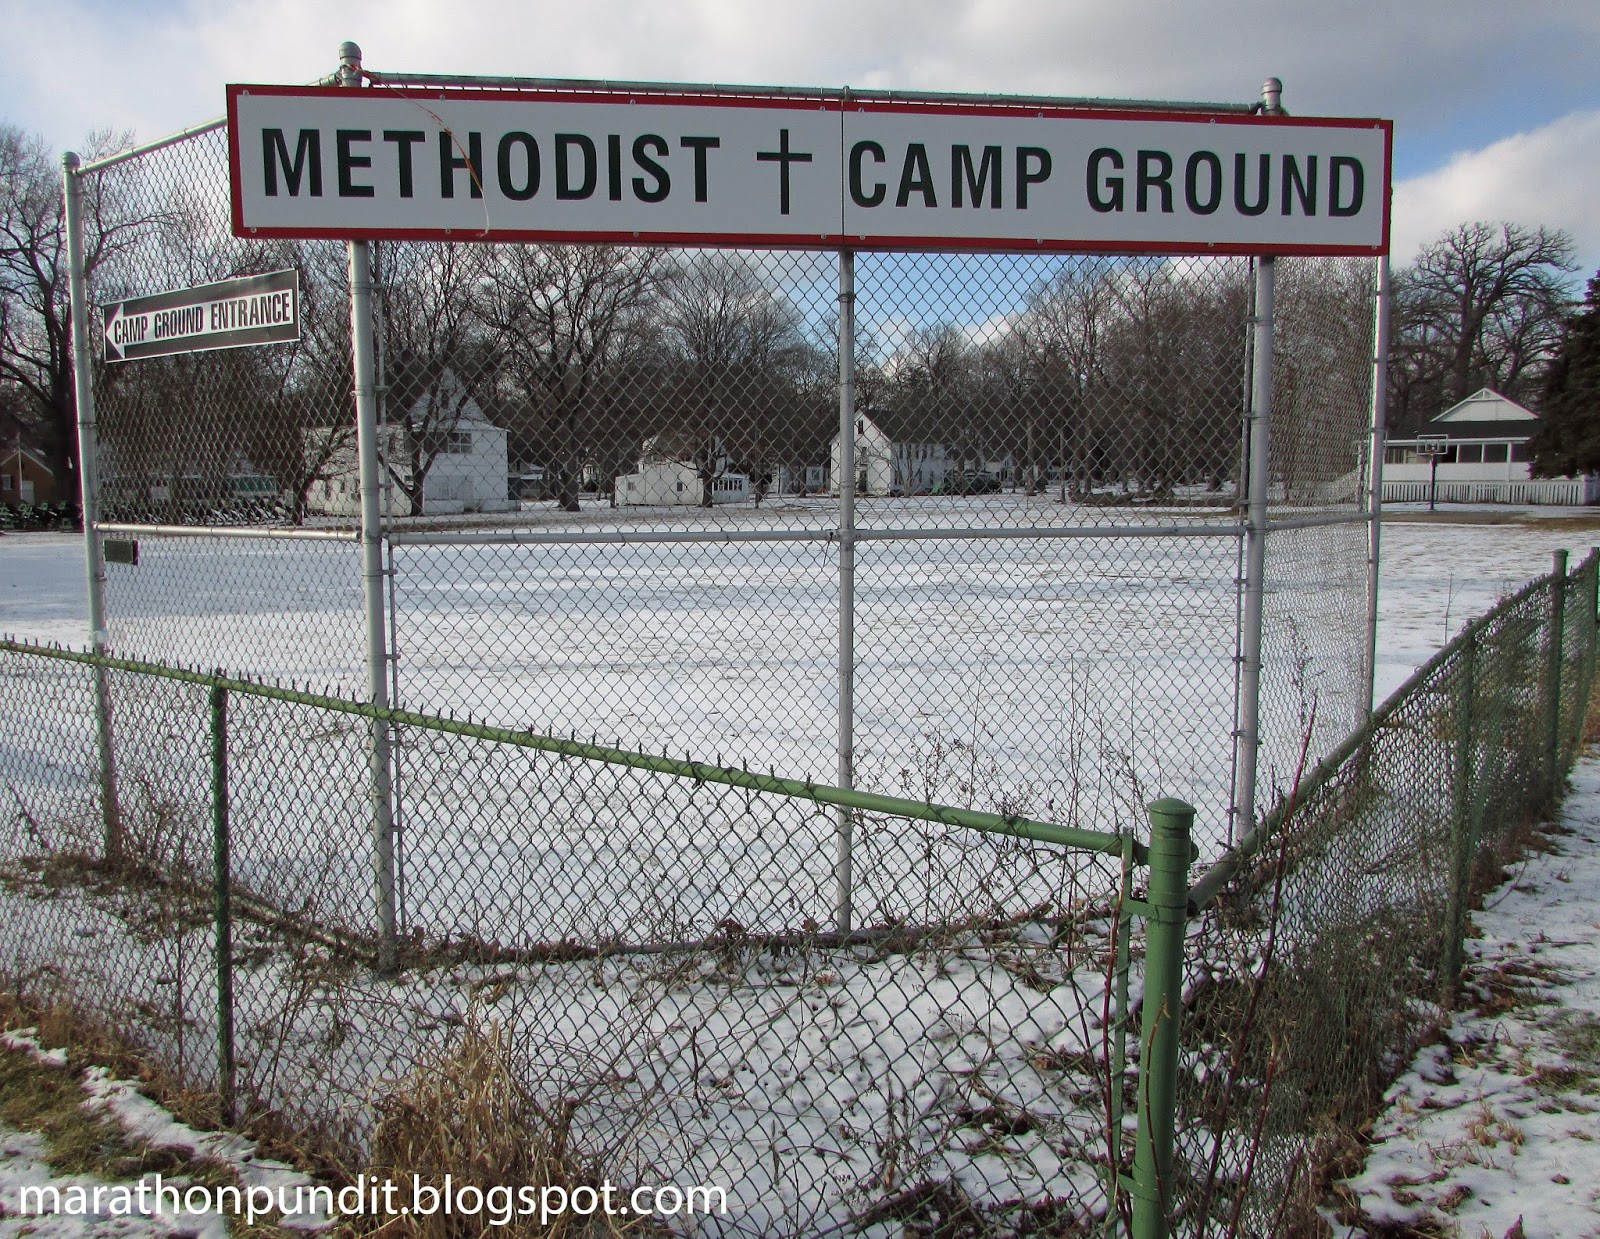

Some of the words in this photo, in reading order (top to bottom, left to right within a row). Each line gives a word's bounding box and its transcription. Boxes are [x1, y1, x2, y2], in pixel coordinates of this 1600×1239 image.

[262, 127, 721, 204] METHODIST
[848, 140, 1053, 210] CAMP
[1086, 147, 1365, 218] GROUND
[114, 315, 148, 345] CAMP
[154, 306, 204, 339] GROUND
[210, 292, 291, 331] ENTRANCE
